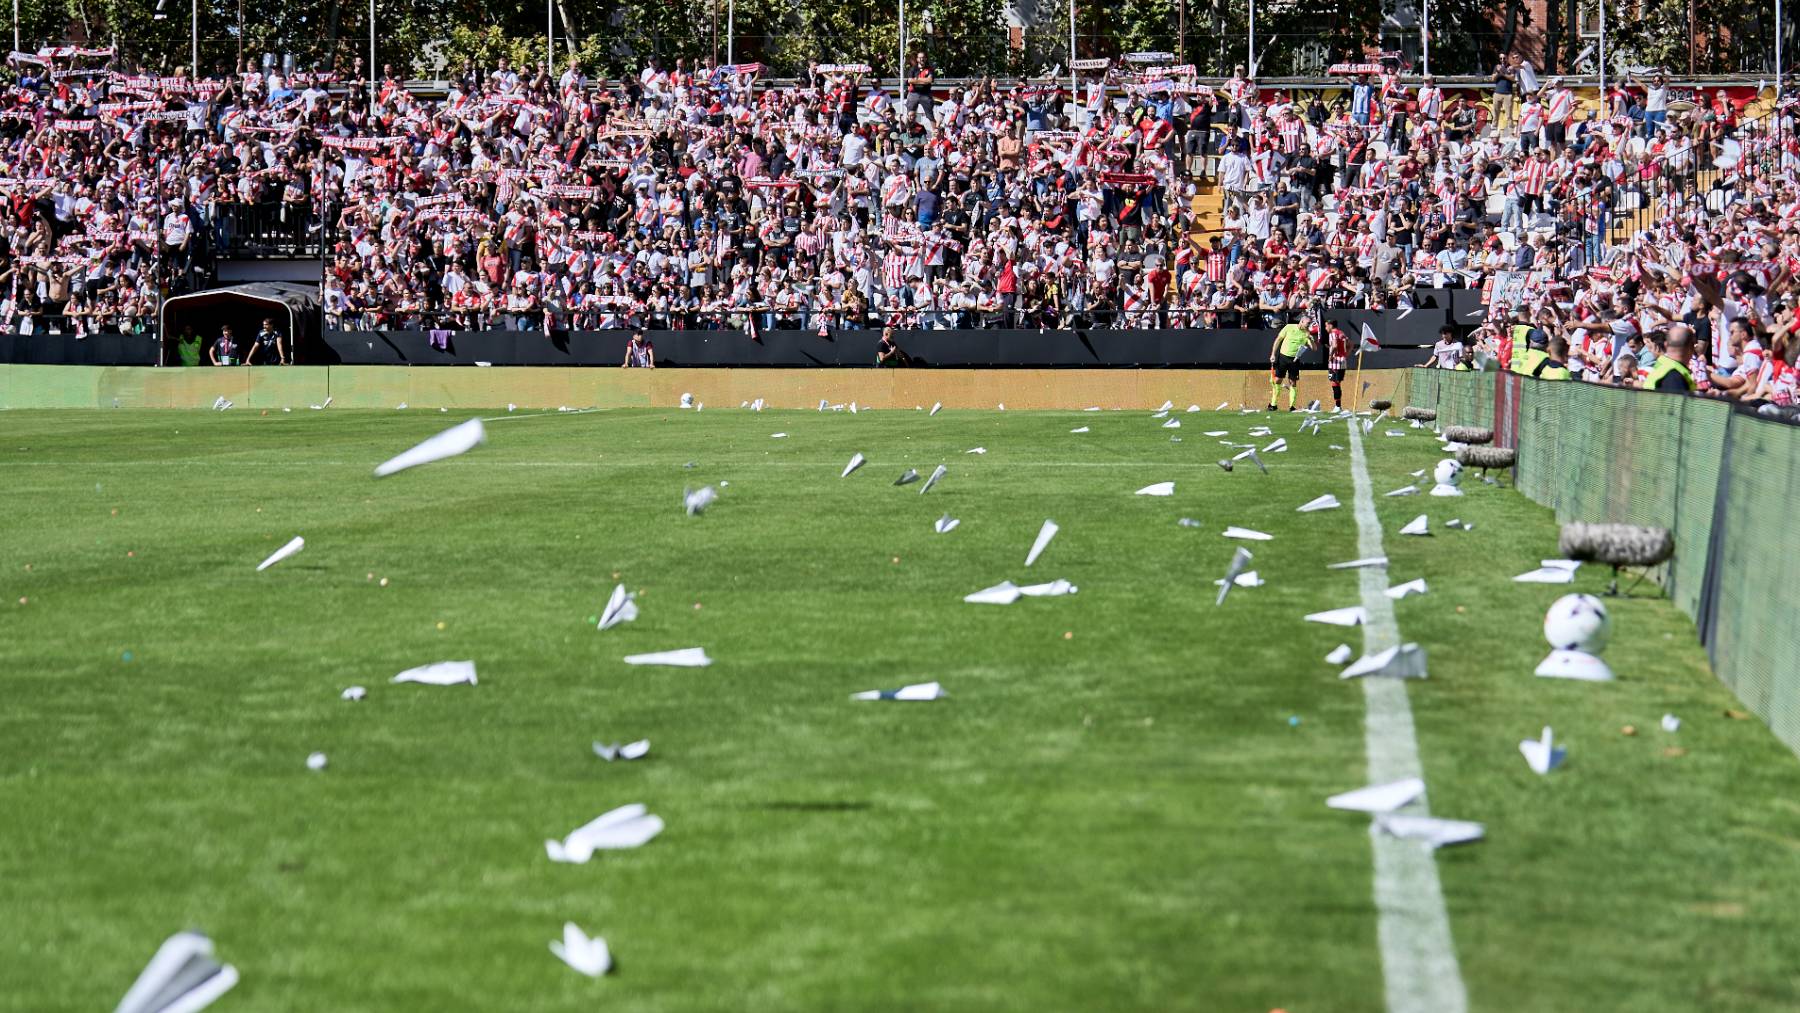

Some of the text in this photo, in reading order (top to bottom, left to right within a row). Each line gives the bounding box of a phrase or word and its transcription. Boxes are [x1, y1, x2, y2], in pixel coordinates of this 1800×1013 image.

[127, 79, 150, 88] PRESA
[160, 77, 180, 86] VETE
[194, 83, 212, 91] VETE
